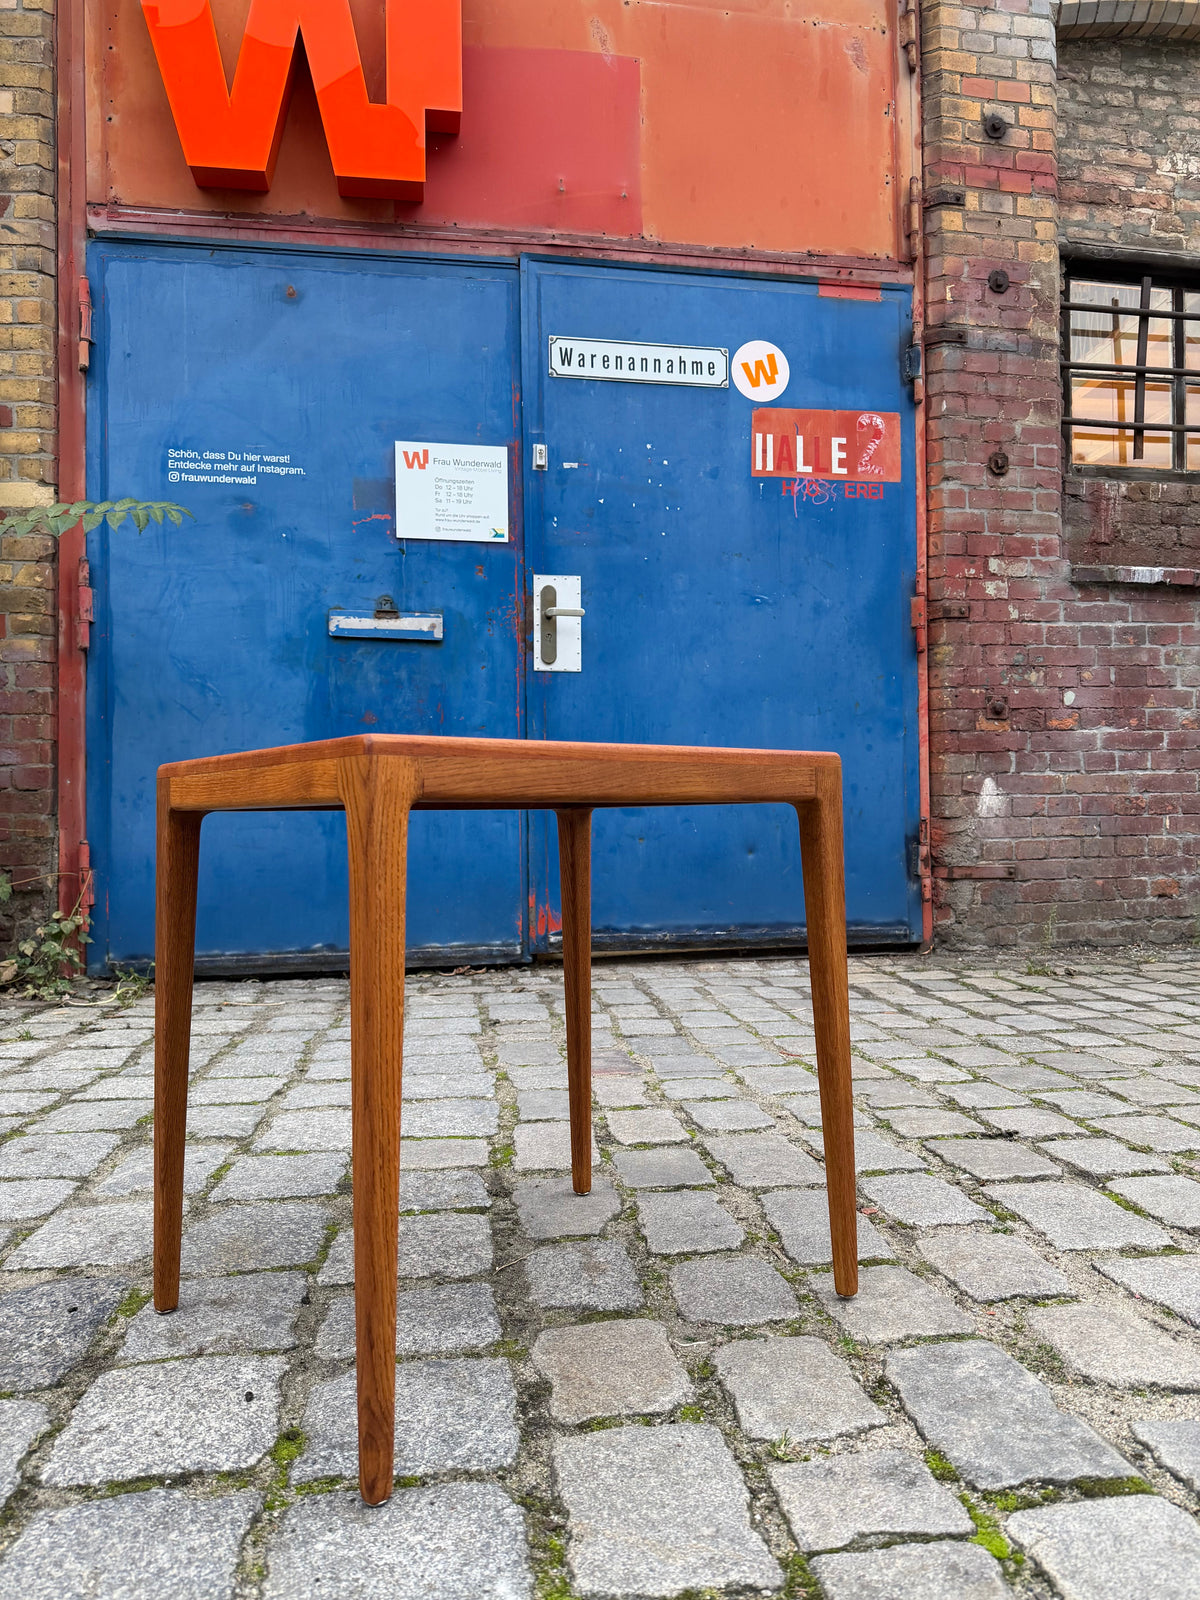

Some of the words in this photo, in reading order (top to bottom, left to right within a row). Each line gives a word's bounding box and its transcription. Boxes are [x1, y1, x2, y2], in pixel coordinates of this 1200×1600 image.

[558, 346, 716, 376] Warenannahme
[755, 432, 848, 475] HALLE
[856, 413, 885, 476] 2
[168, 449, 201, 459] Schön,
[202, 451, 226, 460] dass
[227, 451, 241, 461] Du
[243, 452, 262, 462] hier
[262, 454, 290, 464] warst!
[433, 458, 451, 466] Frau
[452, 458, 502, 468] Wunderwald
[168, 460, 212, 470] Entdecke
[213, 462, 239, 471] mehr
[240, 464, 256, 472] auf
[257, 464, 306, 476] Instagram.
[181, 473, 257, 485] frauwunderwald
